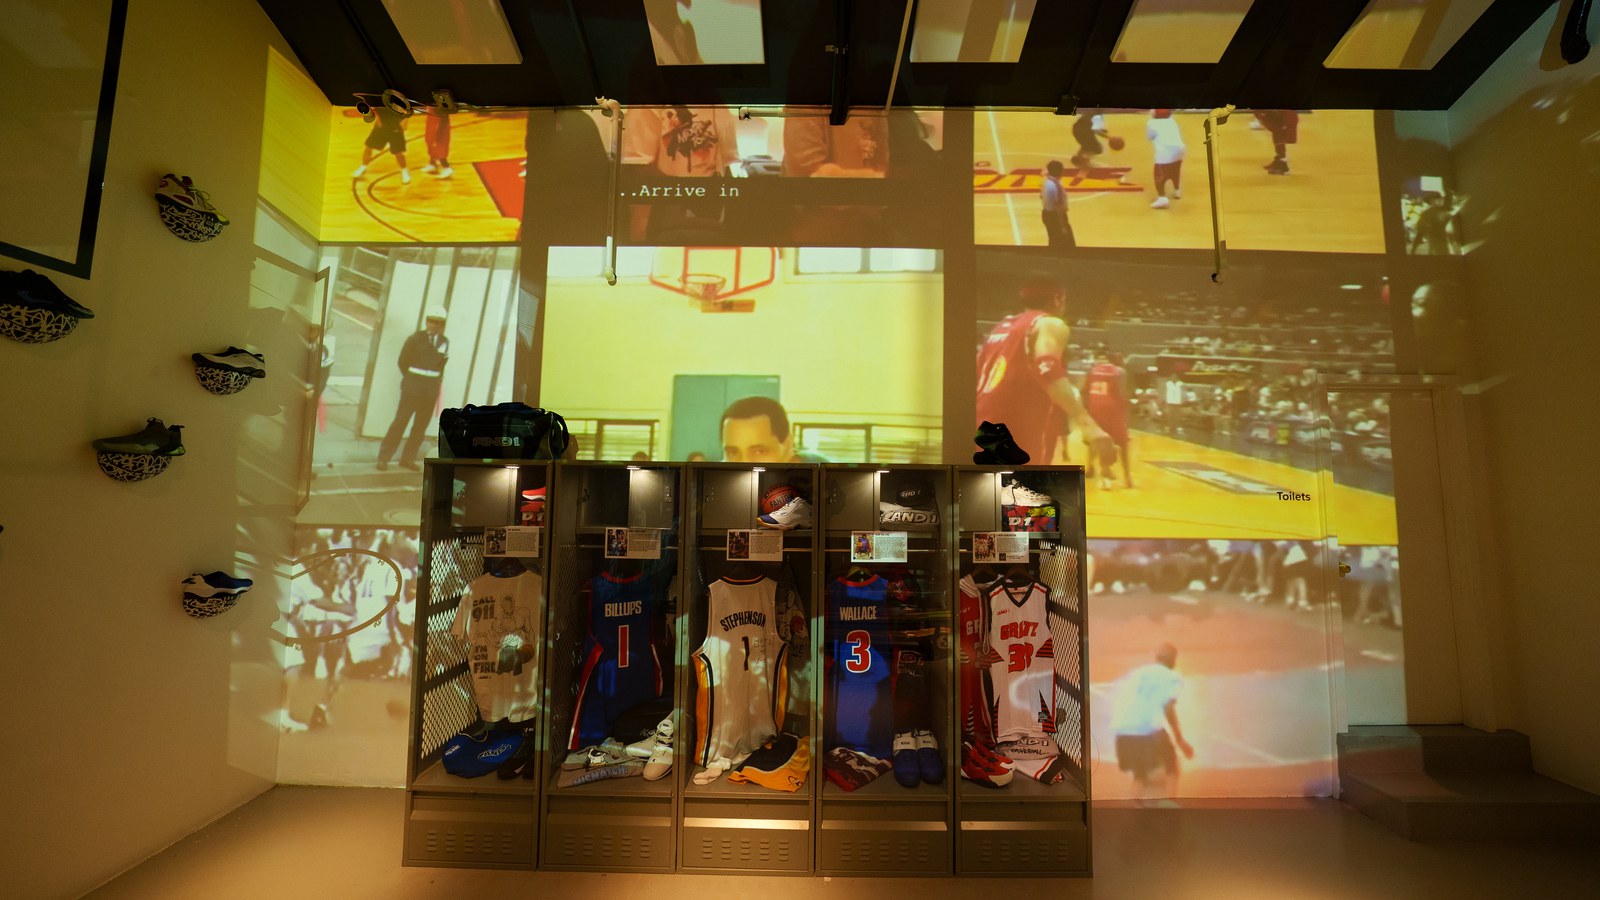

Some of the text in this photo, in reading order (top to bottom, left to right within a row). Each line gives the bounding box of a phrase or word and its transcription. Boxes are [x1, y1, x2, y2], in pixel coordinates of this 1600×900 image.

[719, 184, 739, 197] in
[1276, 491, 1311, 501] Toilets
[604, 600, 643, 618] BILLUPS
[840, 606, 878, 621] WALLACE
[720, 610, 766, 632] STEPHENSON
[618, 624, 630, 669] 1
[741, 636, 750, 672] 1
[845, 629, 872, 674] 3
